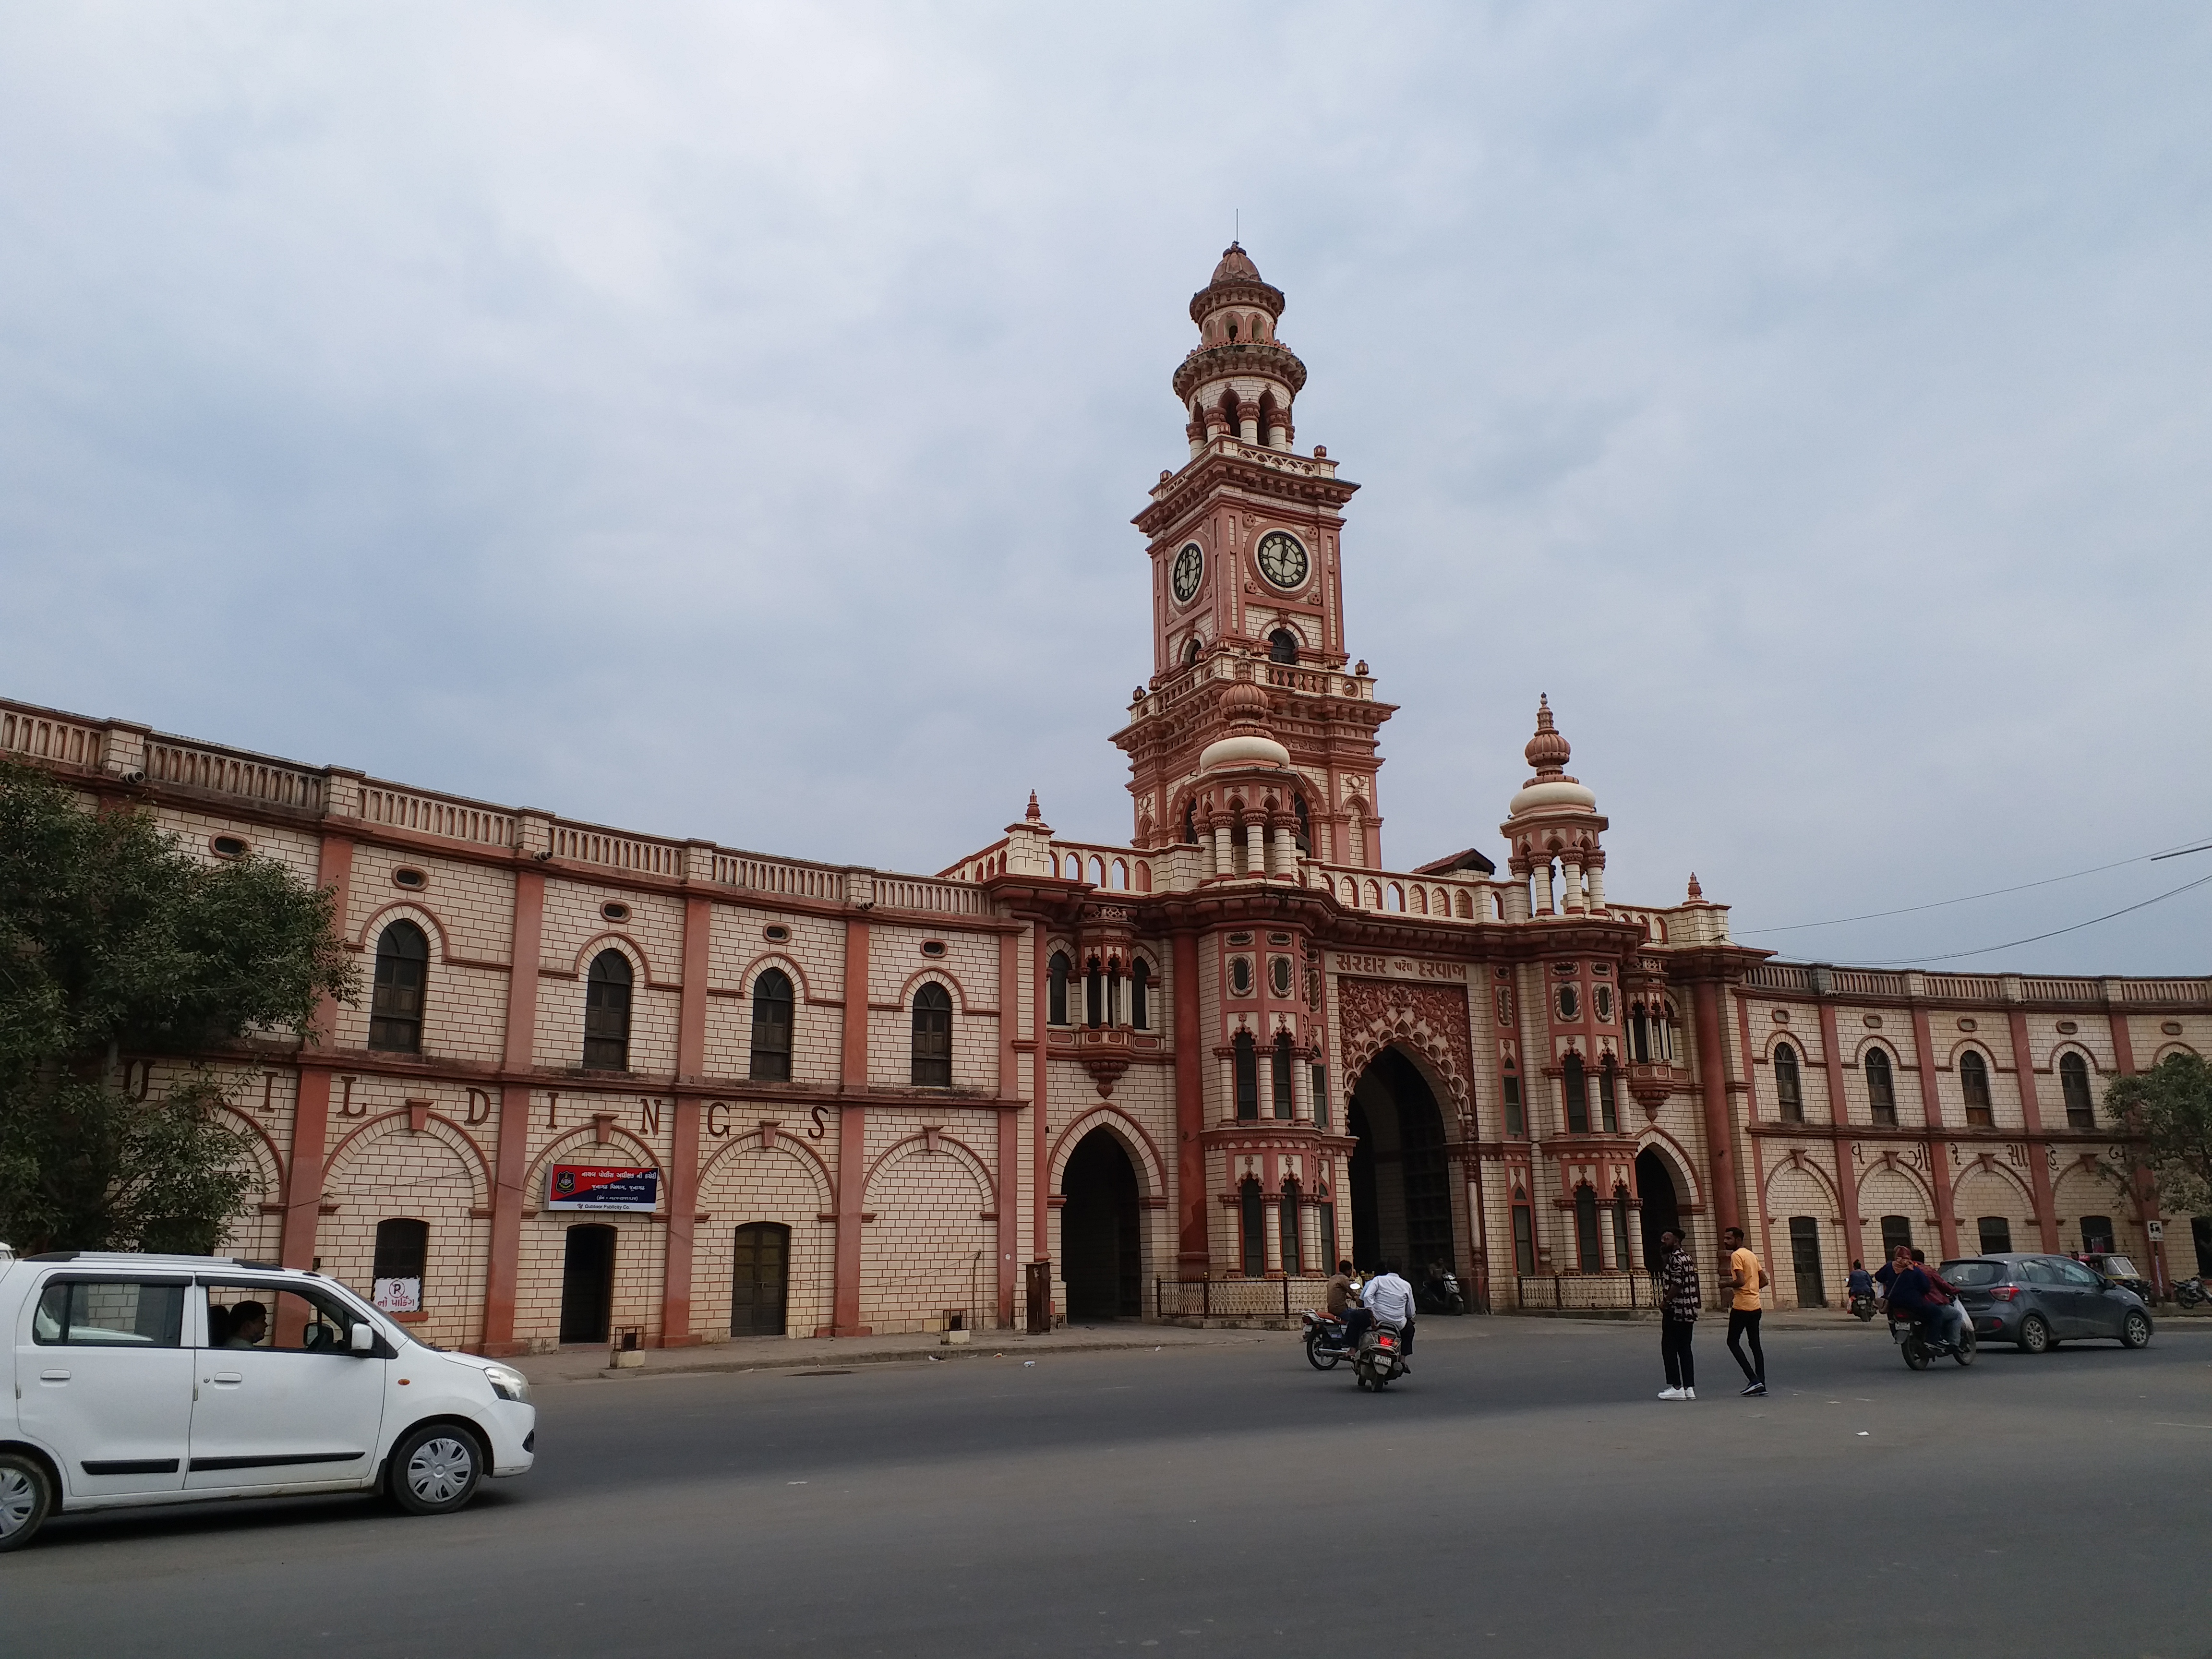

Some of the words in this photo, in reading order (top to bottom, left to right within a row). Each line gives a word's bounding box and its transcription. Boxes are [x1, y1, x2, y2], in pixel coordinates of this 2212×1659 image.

[1336, 954, 1386, 974] સરદાર
[1394, 959, 1412, 972] પટેલ
[1418, 961, 1467, 980] દરવાજા
[377, 1296, 388, 1307] નો
